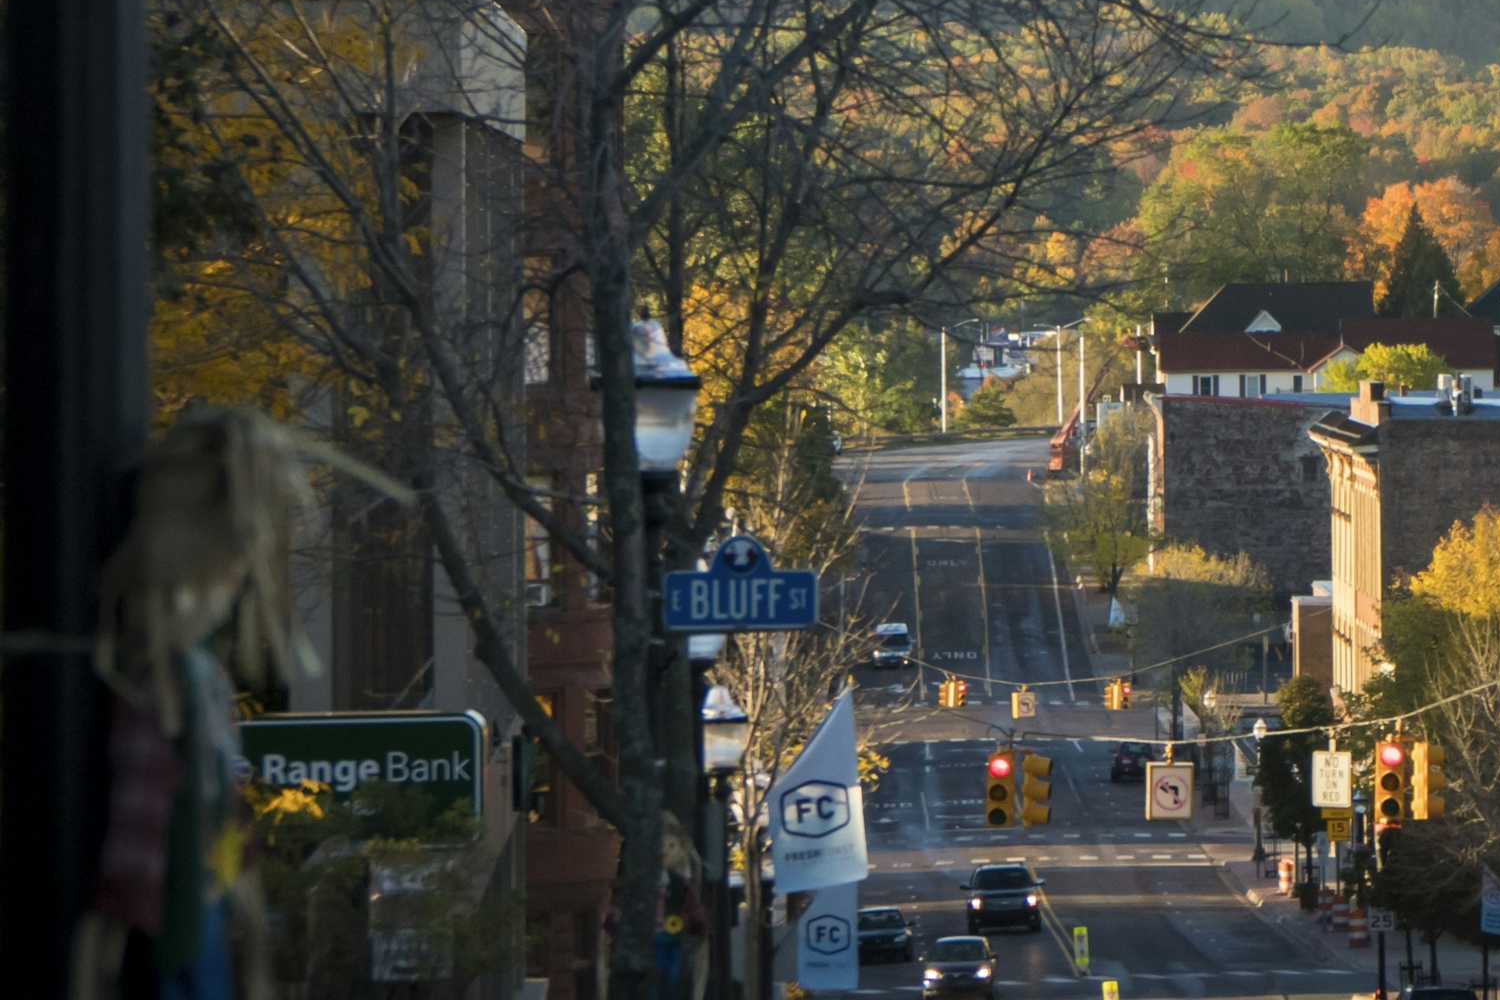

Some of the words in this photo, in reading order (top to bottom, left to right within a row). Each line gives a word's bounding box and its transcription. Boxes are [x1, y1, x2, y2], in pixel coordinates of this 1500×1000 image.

[671, 589, 682, 612] E
[690, 578, 786, 620] BLUFF
[788, 587, 807, 610] ST
[1324, 756, 1339, 769] NO
[262, 753, 380, 792] Range
[386, 751, 472, 783] Bank
[1319, 768, 1344, 779] TURN
[1325, 780, 1338, 790] ON
[1322, 791, 1341, 802] RED
[795, 795, 835, 824] FC
[1331, 822, 1345, 833] 15
[1370, 914, 1393, 928] 25
[815, 925, 841, 944] FC
